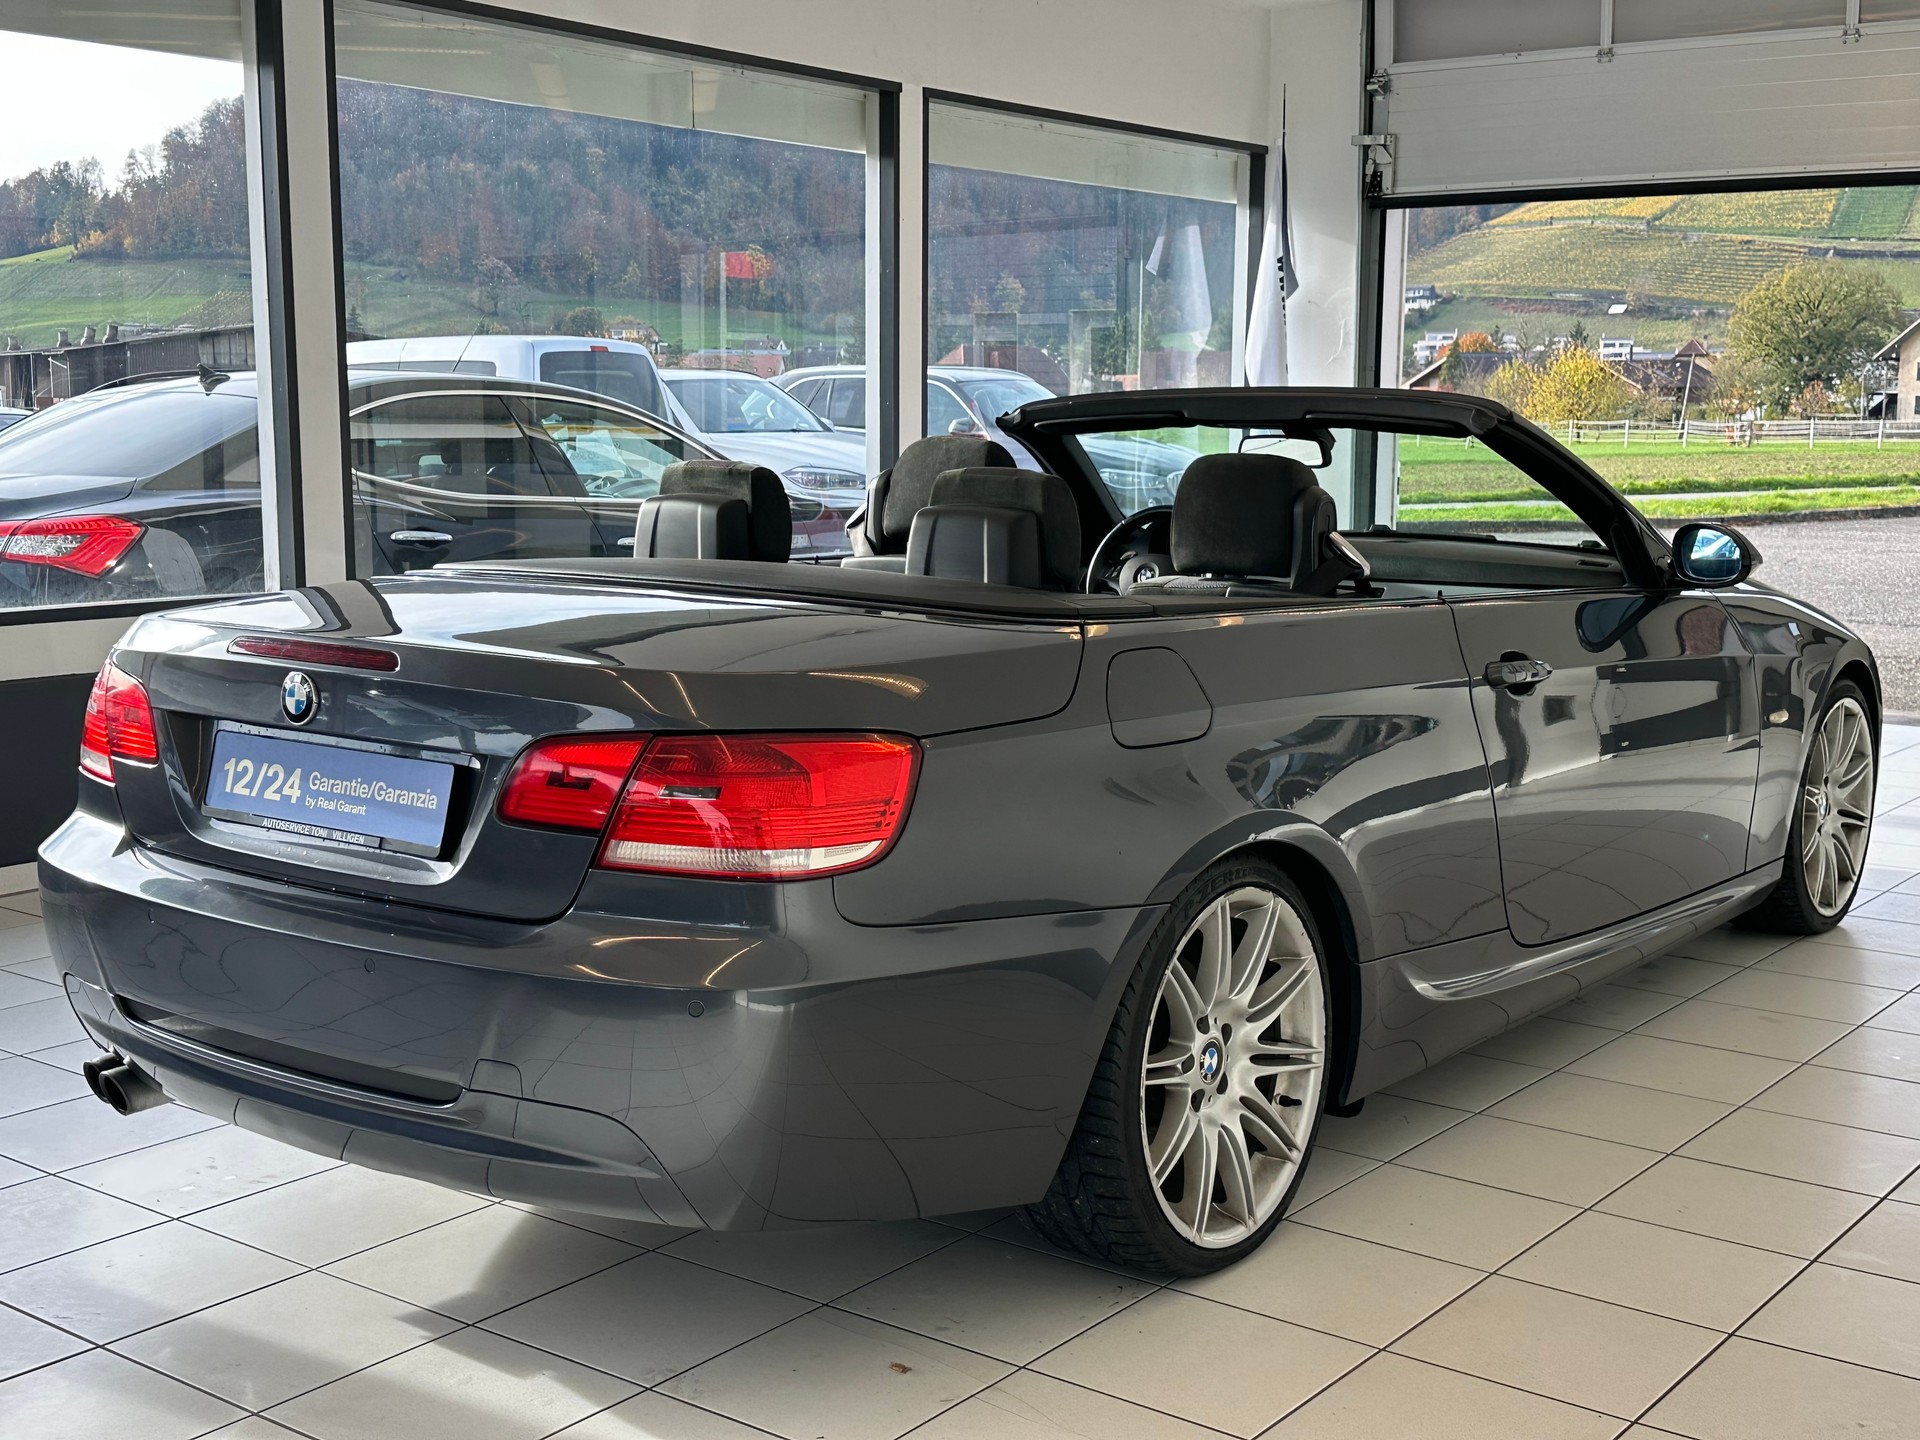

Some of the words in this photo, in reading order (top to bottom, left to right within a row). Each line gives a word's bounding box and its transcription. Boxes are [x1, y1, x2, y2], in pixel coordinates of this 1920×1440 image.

[224, 757, 302, 804] 12/24
[309, 771, 437, 809] Garantie/Garanzia
[305, 794, 316, 809] by
[317, 796, 336, 810] Real
[338, 800, 366, 815] Garant
[262, 818, 310, 834] AUTOSERVICE
[310, 826, 328, 838] TONI
[333, 829, 365, 845] VILLIGEN
